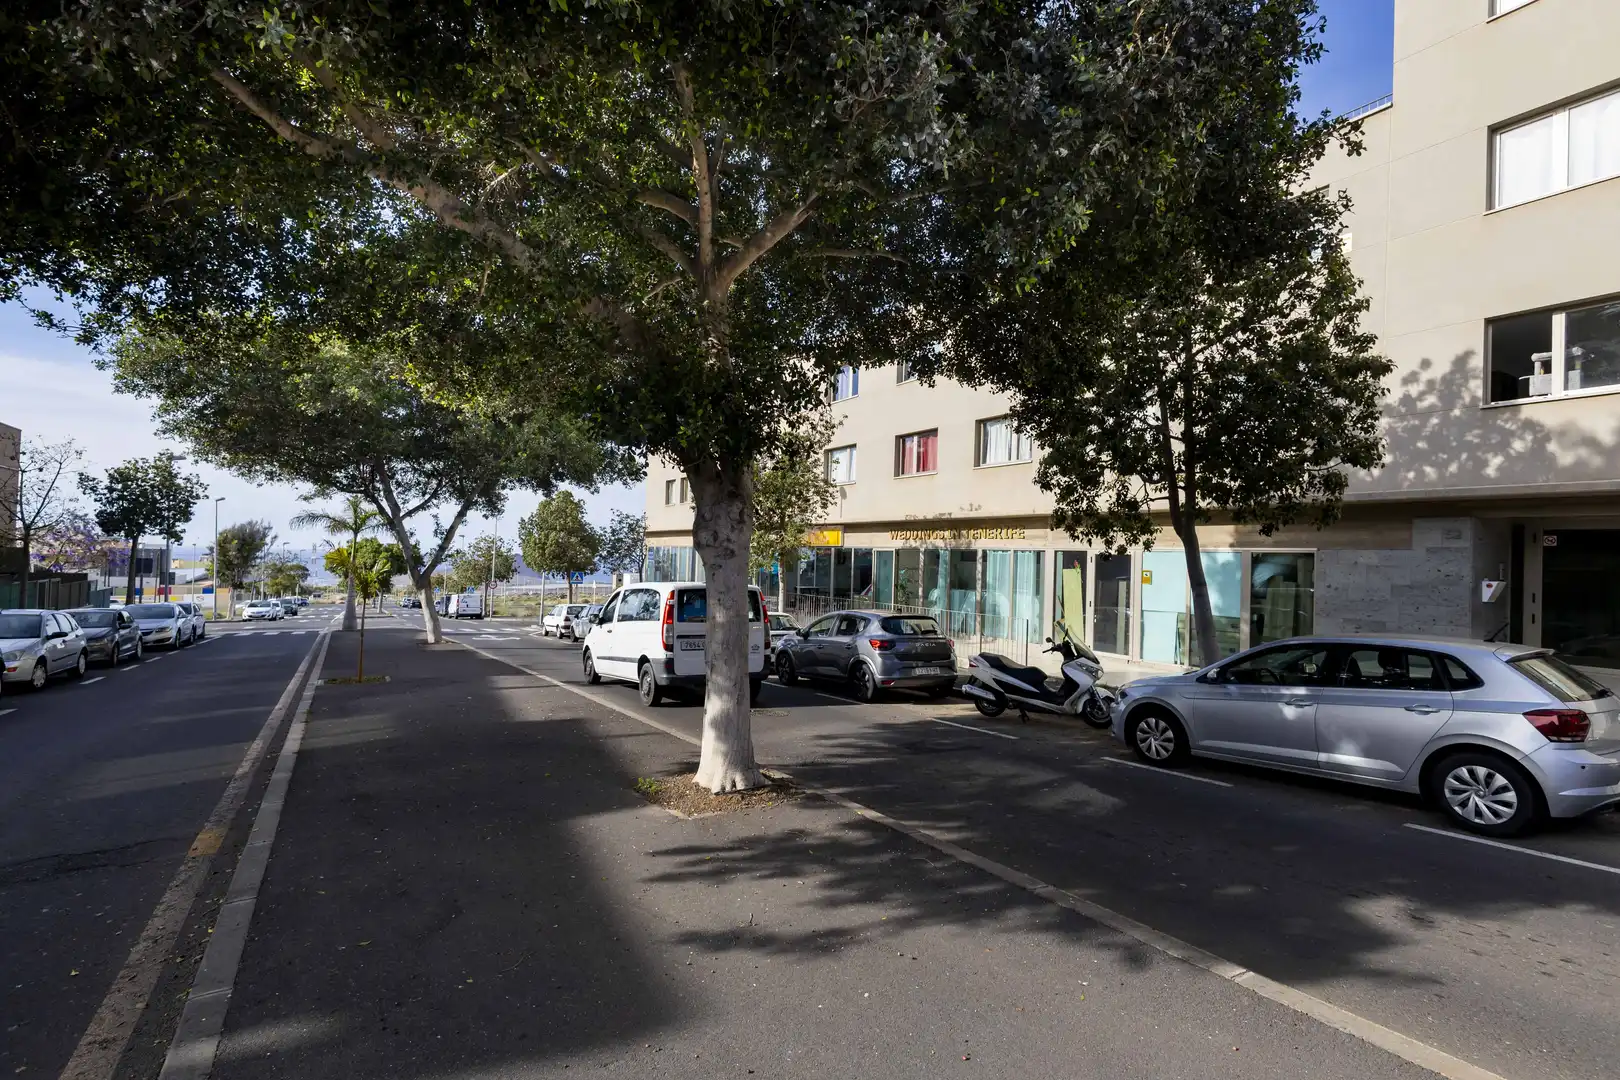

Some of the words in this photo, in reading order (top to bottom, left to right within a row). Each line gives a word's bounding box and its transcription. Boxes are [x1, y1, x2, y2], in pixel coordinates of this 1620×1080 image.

[889, 529, 945, 541] WEDDINGS
[947, 528, 960, 540] IN
[961, 526, 1026, 540] TENERIFE
